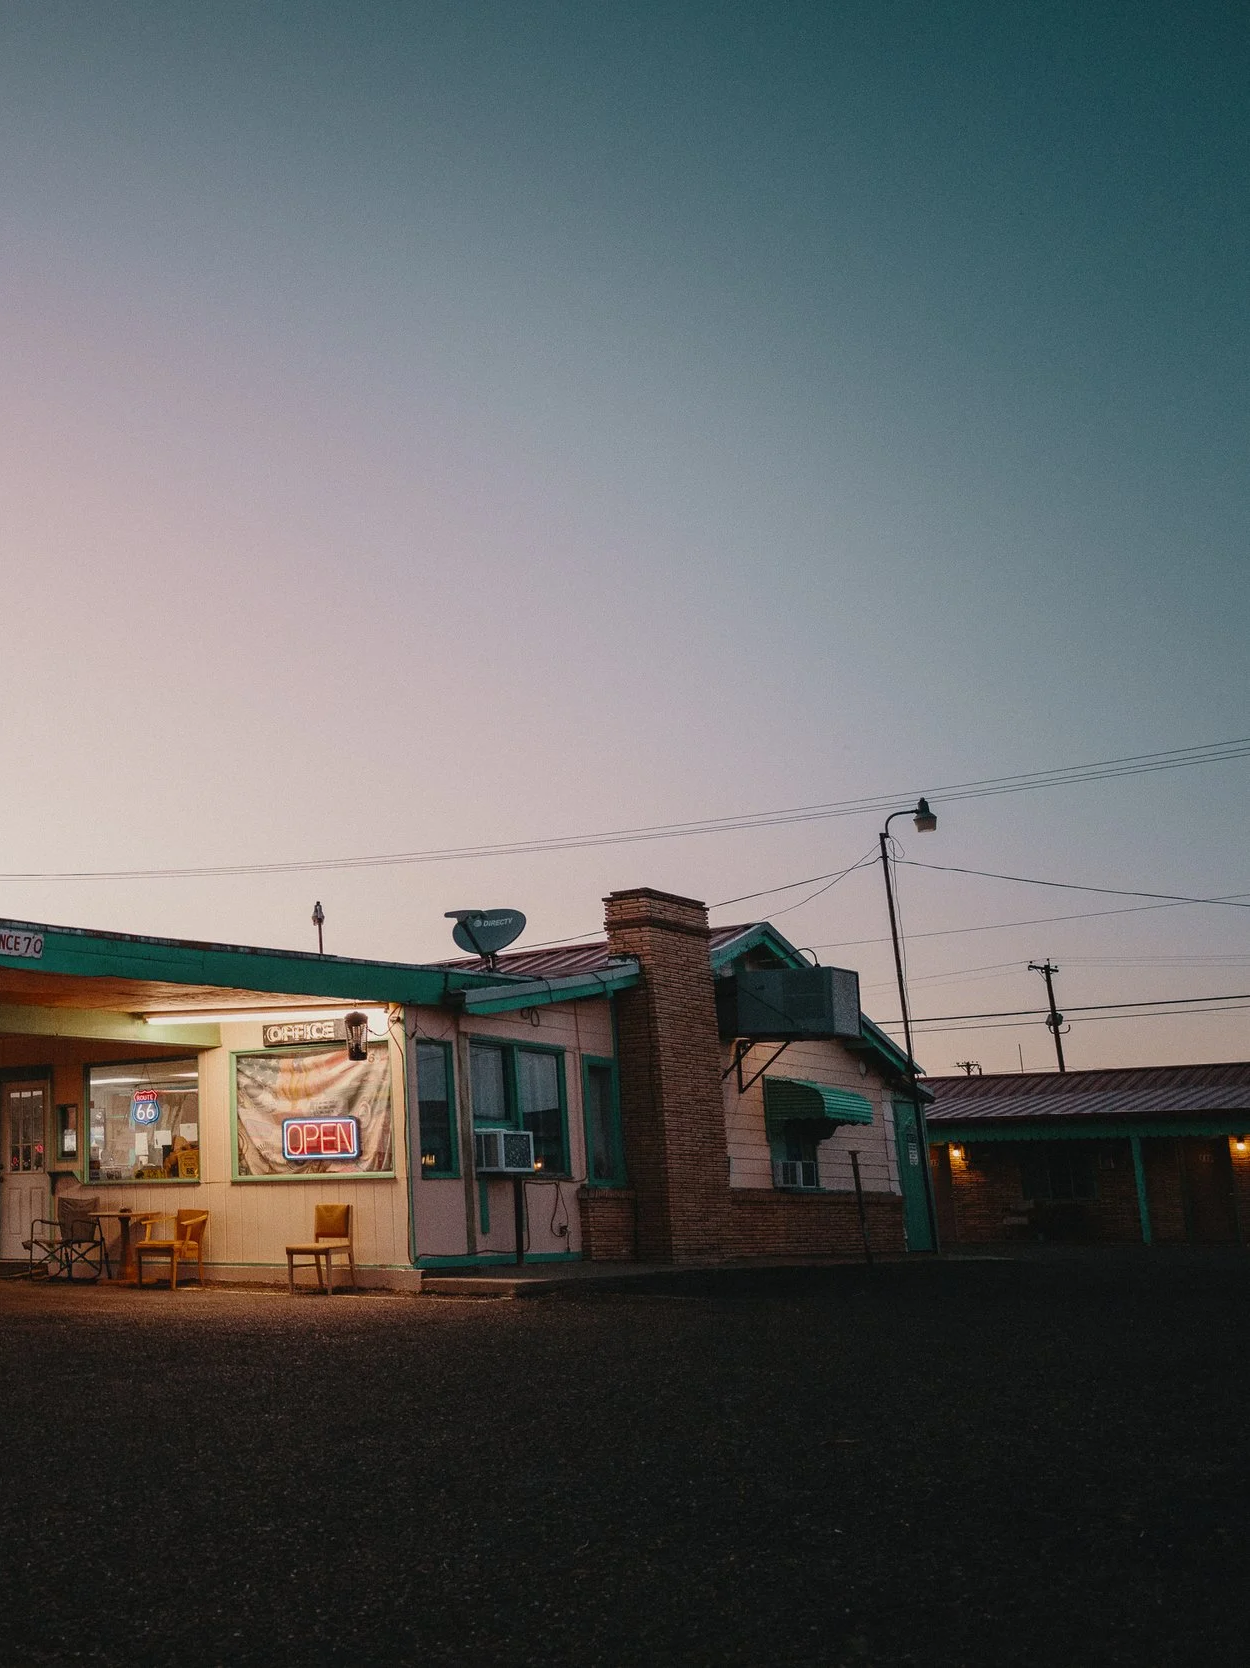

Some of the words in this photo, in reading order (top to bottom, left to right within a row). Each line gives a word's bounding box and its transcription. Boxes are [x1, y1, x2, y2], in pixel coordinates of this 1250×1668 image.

[483, 917, 513, 927] DIRECTV
[266, 1022, 335, 1042] OFFICE
[136, 1103, 155, 1121] 66
[287, 1123, 354, 1155] OPEN
